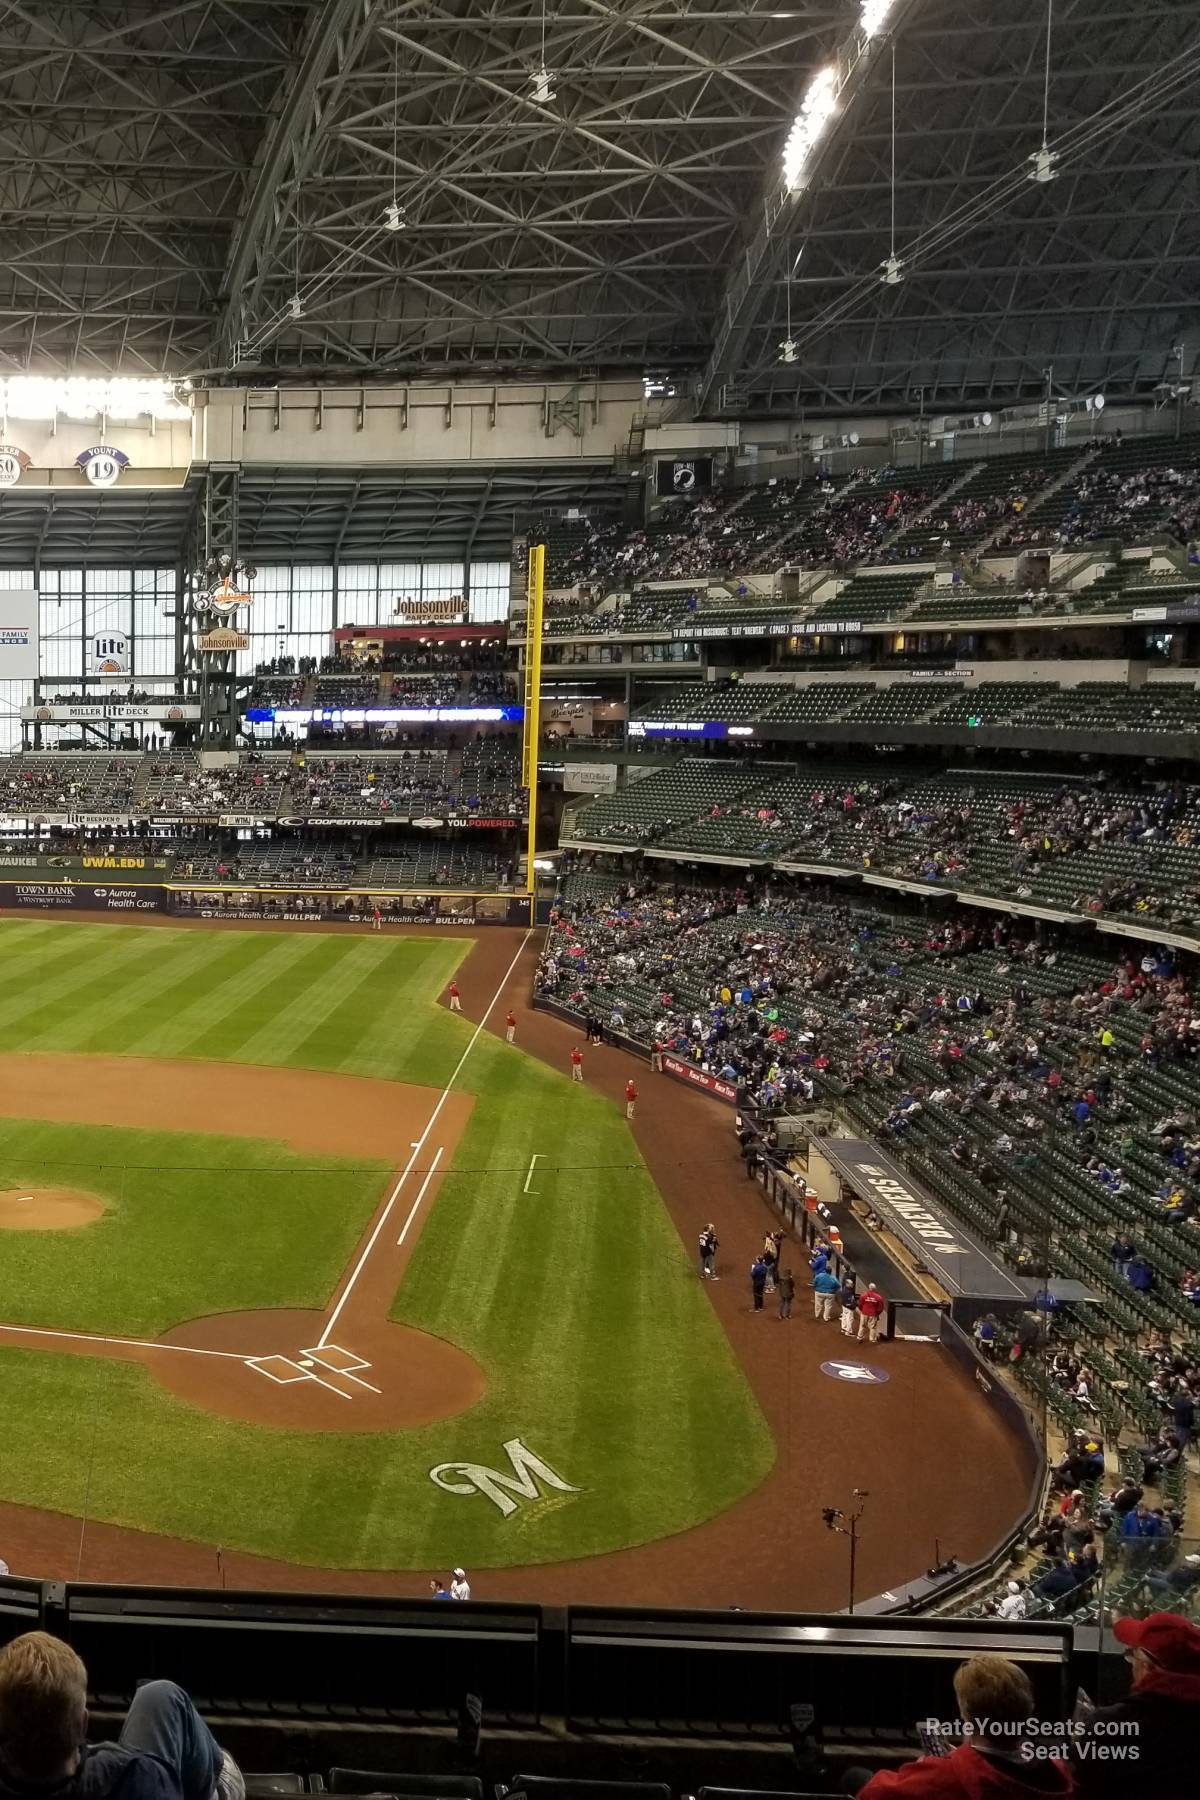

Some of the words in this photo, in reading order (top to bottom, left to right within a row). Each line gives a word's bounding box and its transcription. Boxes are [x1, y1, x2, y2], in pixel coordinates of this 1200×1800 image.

[88, 448, 117, 457] YOUNT
[93, 462, 115, 479] 19
[393, 595, 468, 616] Johnsonville
[96, 639, 124, 658] Lite
[200, 636, 247, 649] Johnsonville
[70, 708, 101, 716] MILLER
[103, 705, 125, 719] Lite
[82, 856, 145, 868] UWM.EDU
[16, 885, 46, 894] TOWN
[47, 886, 75, 895] BANK
[108, 889, 136, 898] Aurora
[108, 899, 136, 908] Health
[137, 900, 156, 908] Care
[239, 911, 261, 919] Health
[436, 917, 475, 925] BULLPEN
[867, 1178, 954, 1239] BREWERS
[429, 1437, 585, 1518] M
